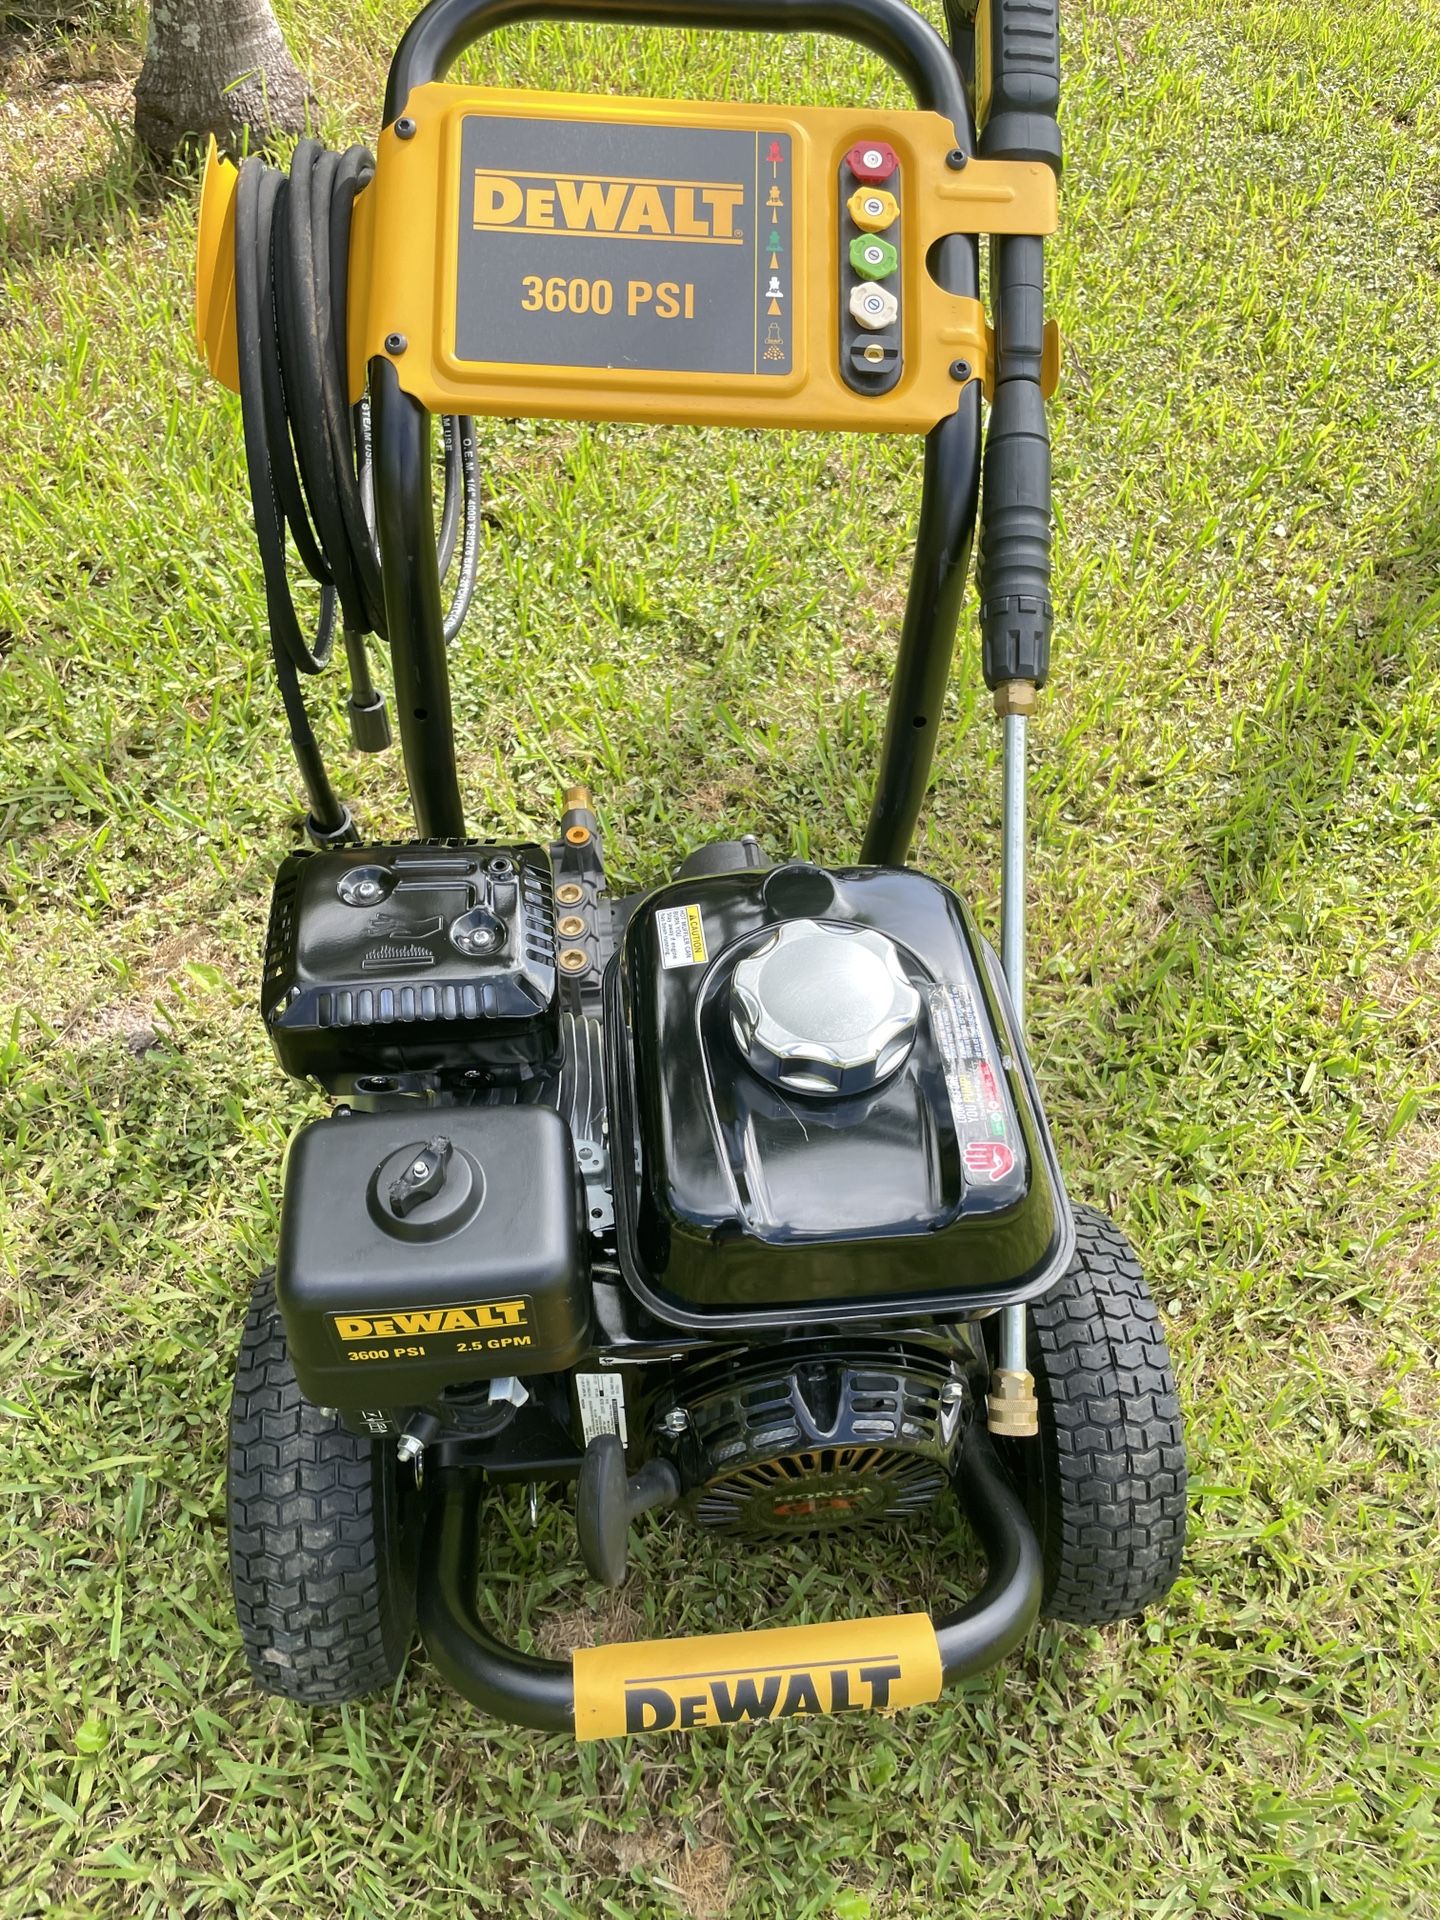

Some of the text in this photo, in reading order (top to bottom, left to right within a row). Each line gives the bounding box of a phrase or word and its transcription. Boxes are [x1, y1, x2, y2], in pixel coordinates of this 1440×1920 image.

[473, 175, 744, 237] DEWALT
[521, 275, 694, 319] 3600 PSI
[361, 402, 372, 442] STEAM
[467, 499, 477, 521] 4000
[674, 926, 682, 937] YOU
[690, 921, 702, 953] CAUTION
[964, 1104, 979, 1123] YOU
[334, 1303, 526, 1338] DEWALT
[347, 1346, 426, 1361] 3600 PSI
[456, 1336, 531, 1352] 2.5 GPM
[624, 1664, 901, 1734] DEWALT
